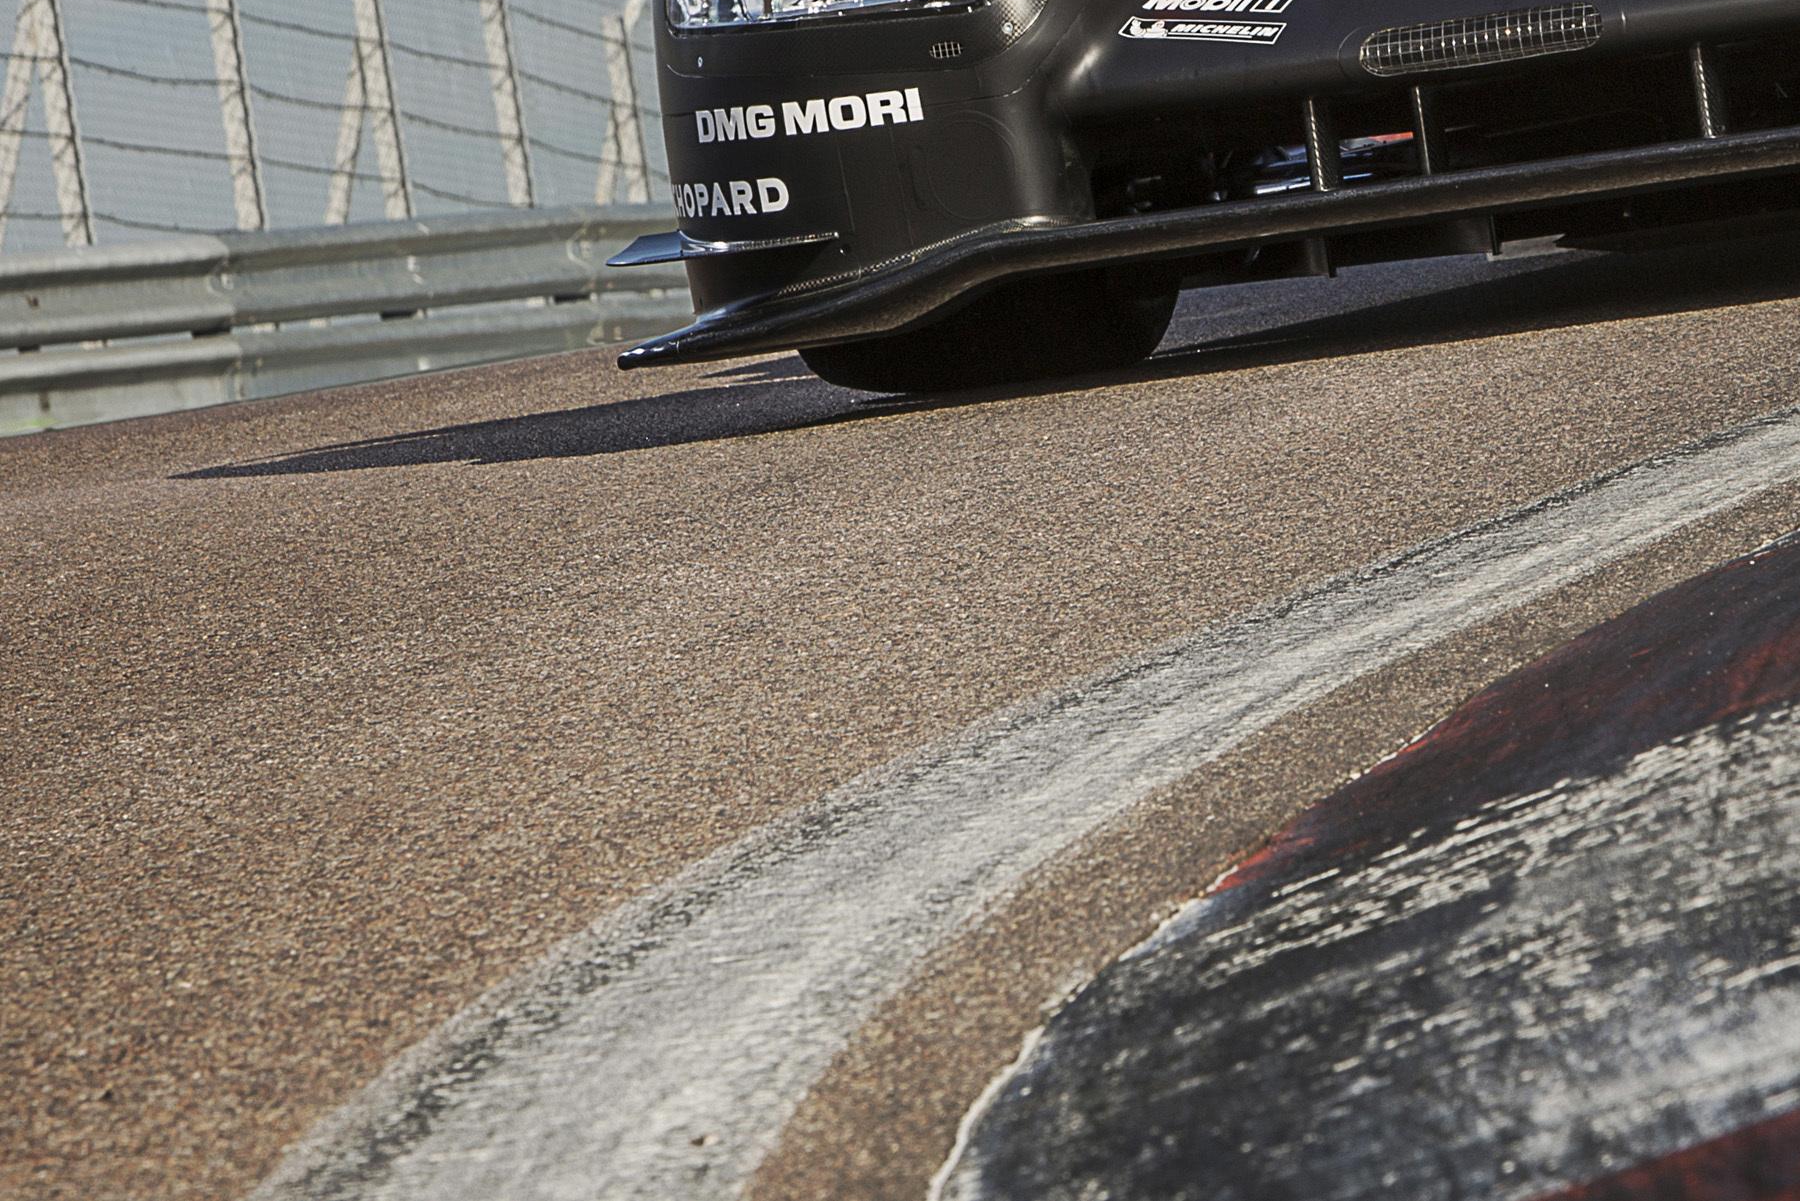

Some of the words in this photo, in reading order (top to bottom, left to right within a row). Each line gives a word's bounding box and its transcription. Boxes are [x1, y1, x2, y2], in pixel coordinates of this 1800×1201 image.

[1170, 22, 1282, 38] MICHELIN
[695, 104, 776, 143] DMG
[781, 87, 924, 136] MORI
[671, 177, 789, 218] HOPARD
